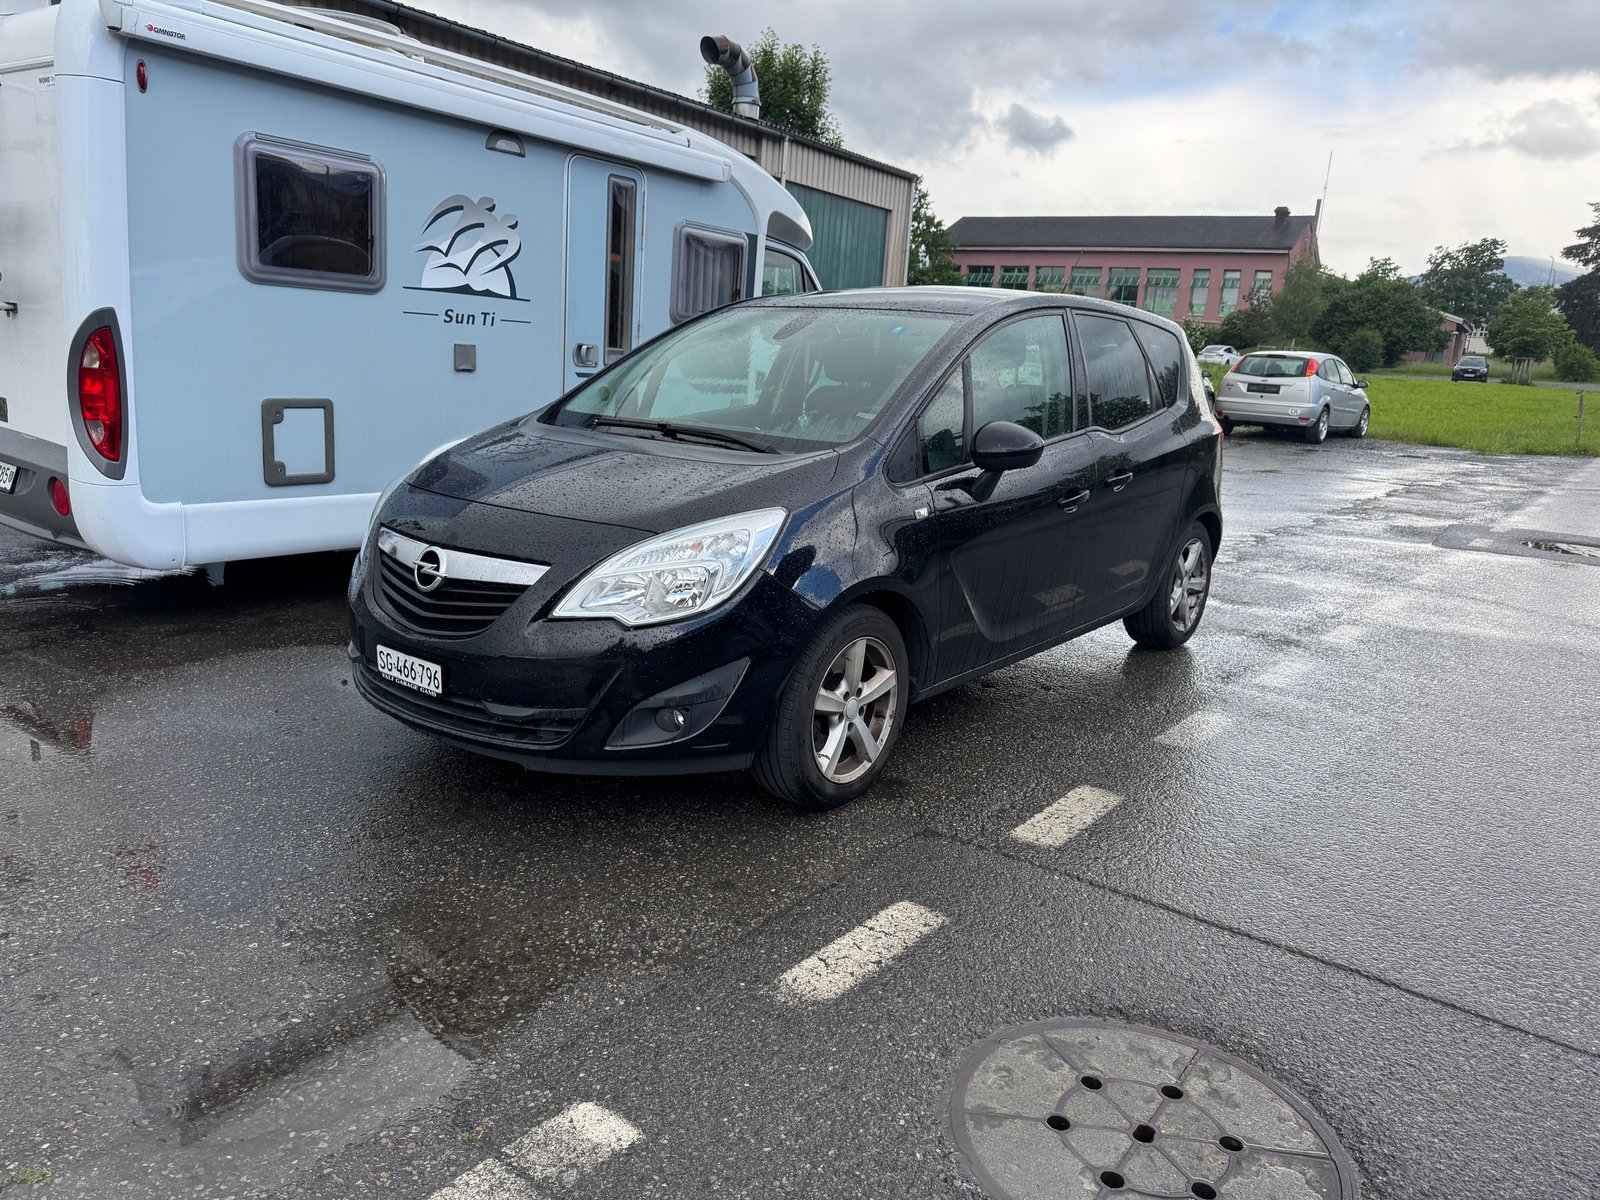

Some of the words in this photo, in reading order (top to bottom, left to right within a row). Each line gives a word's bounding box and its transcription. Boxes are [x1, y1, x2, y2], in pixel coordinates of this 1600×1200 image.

[153, 26, 186, 40] OMNISTOR
[443, 308, 475, 325] Sun
[480, 311, 496, 327] Ti
[395, 677, 419, 691] GARAGE
